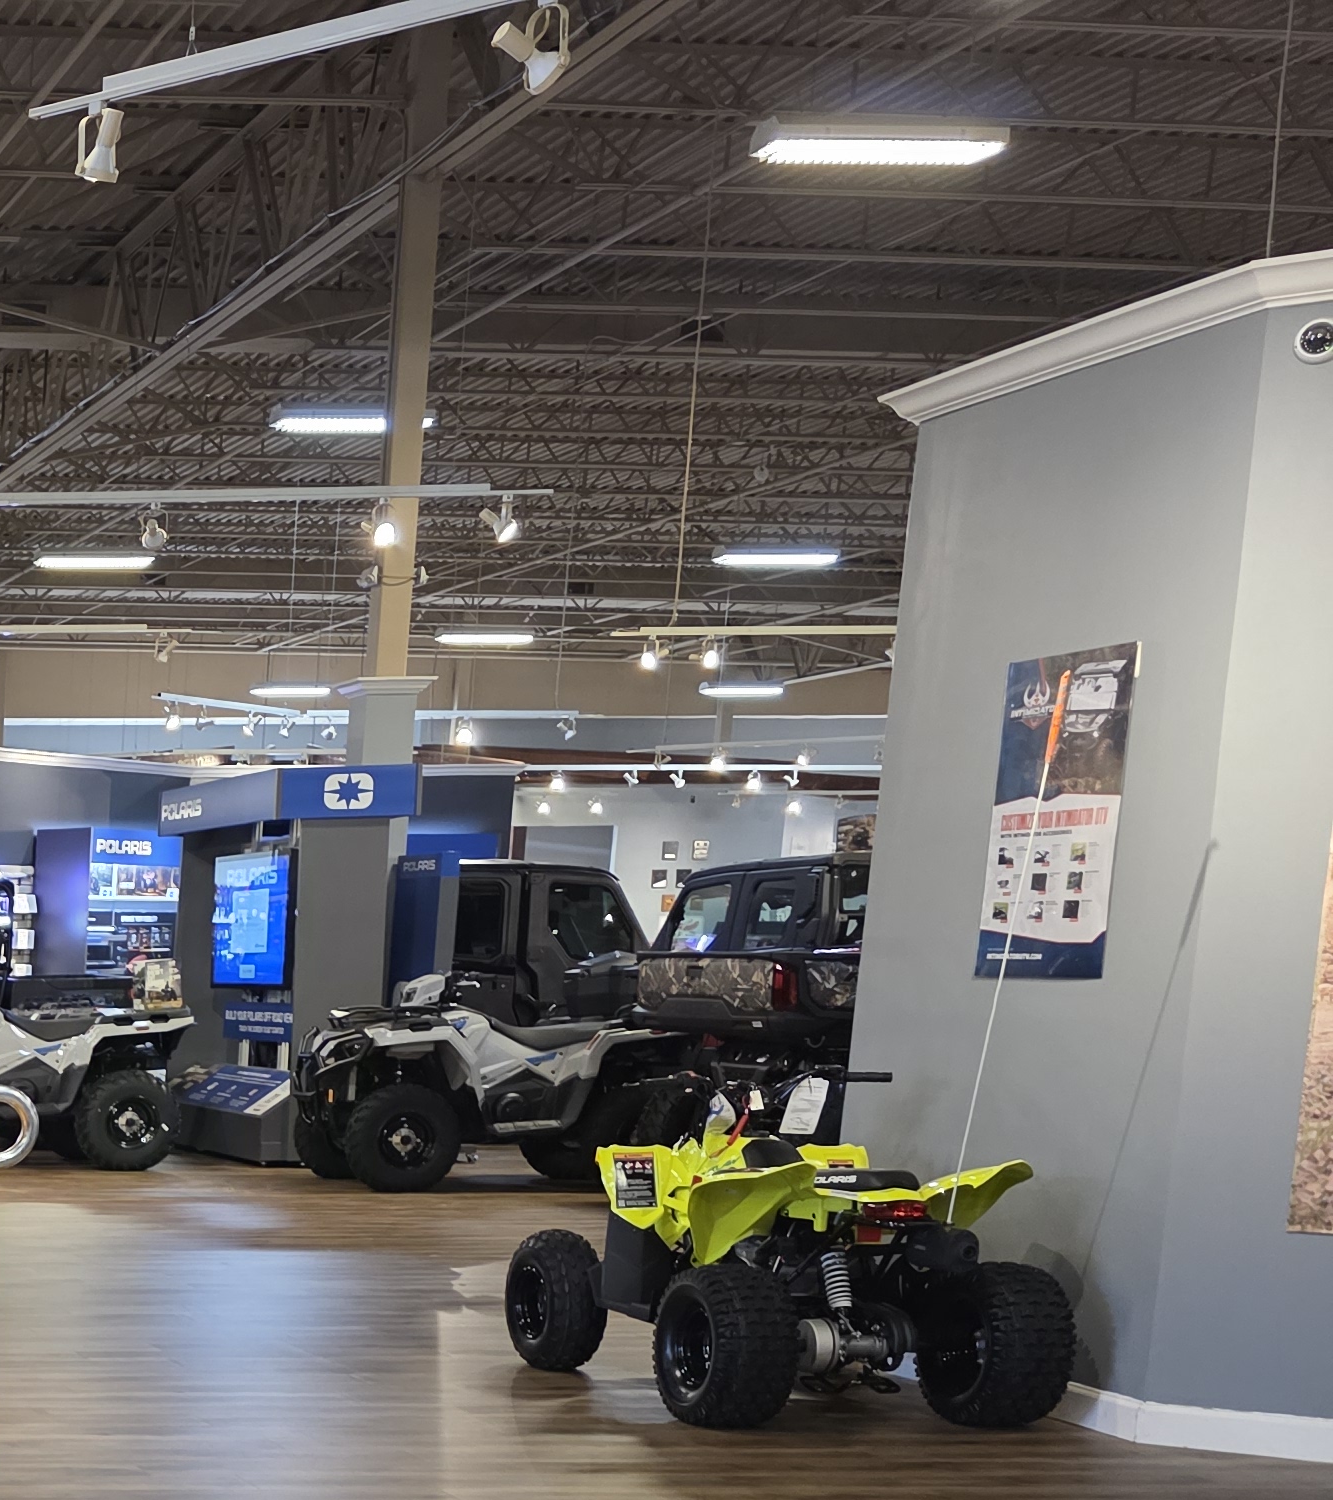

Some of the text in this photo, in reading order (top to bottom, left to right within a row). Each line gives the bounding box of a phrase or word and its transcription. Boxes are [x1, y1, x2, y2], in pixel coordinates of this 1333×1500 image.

[161, 799, 203, 822] POLARIS
[96, 838, 153, 856] POLARIS
[403, 859, 436, 872] POLARIS
[225, 865, 278, 888] POLARIS
